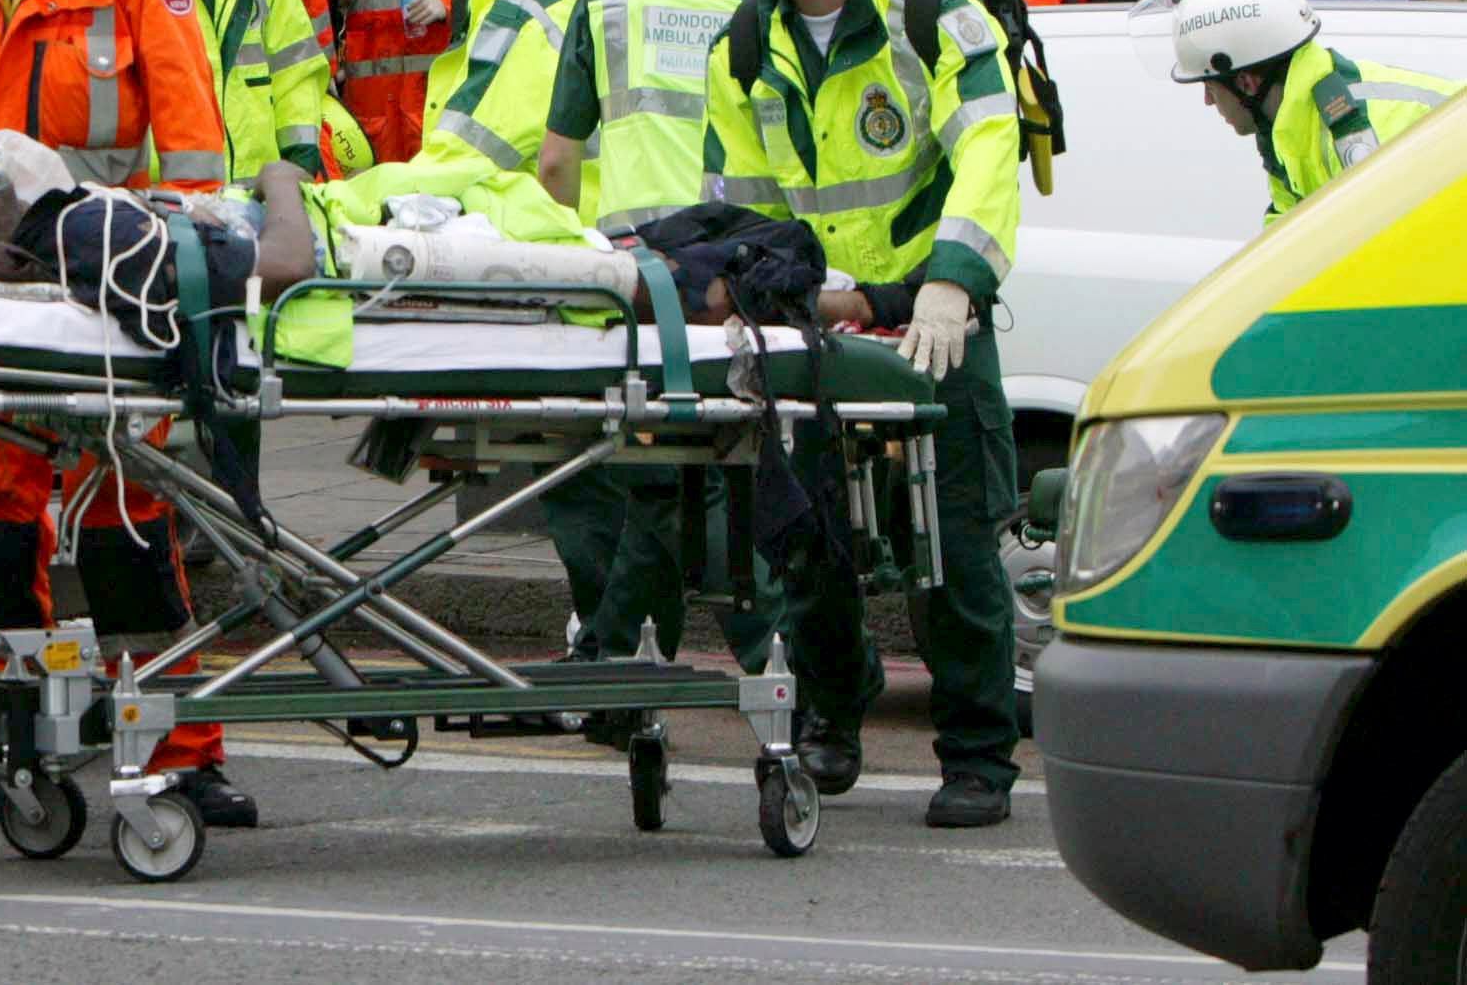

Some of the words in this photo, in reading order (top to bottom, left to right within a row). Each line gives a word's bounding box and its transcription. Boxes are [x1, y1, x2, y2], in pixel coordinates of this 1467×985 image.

[659, 12, 725, 30] LONDON
[1179, 2, 1262, 37] AMBULANCE
[644, 27, 716, 47] AMBULAN
